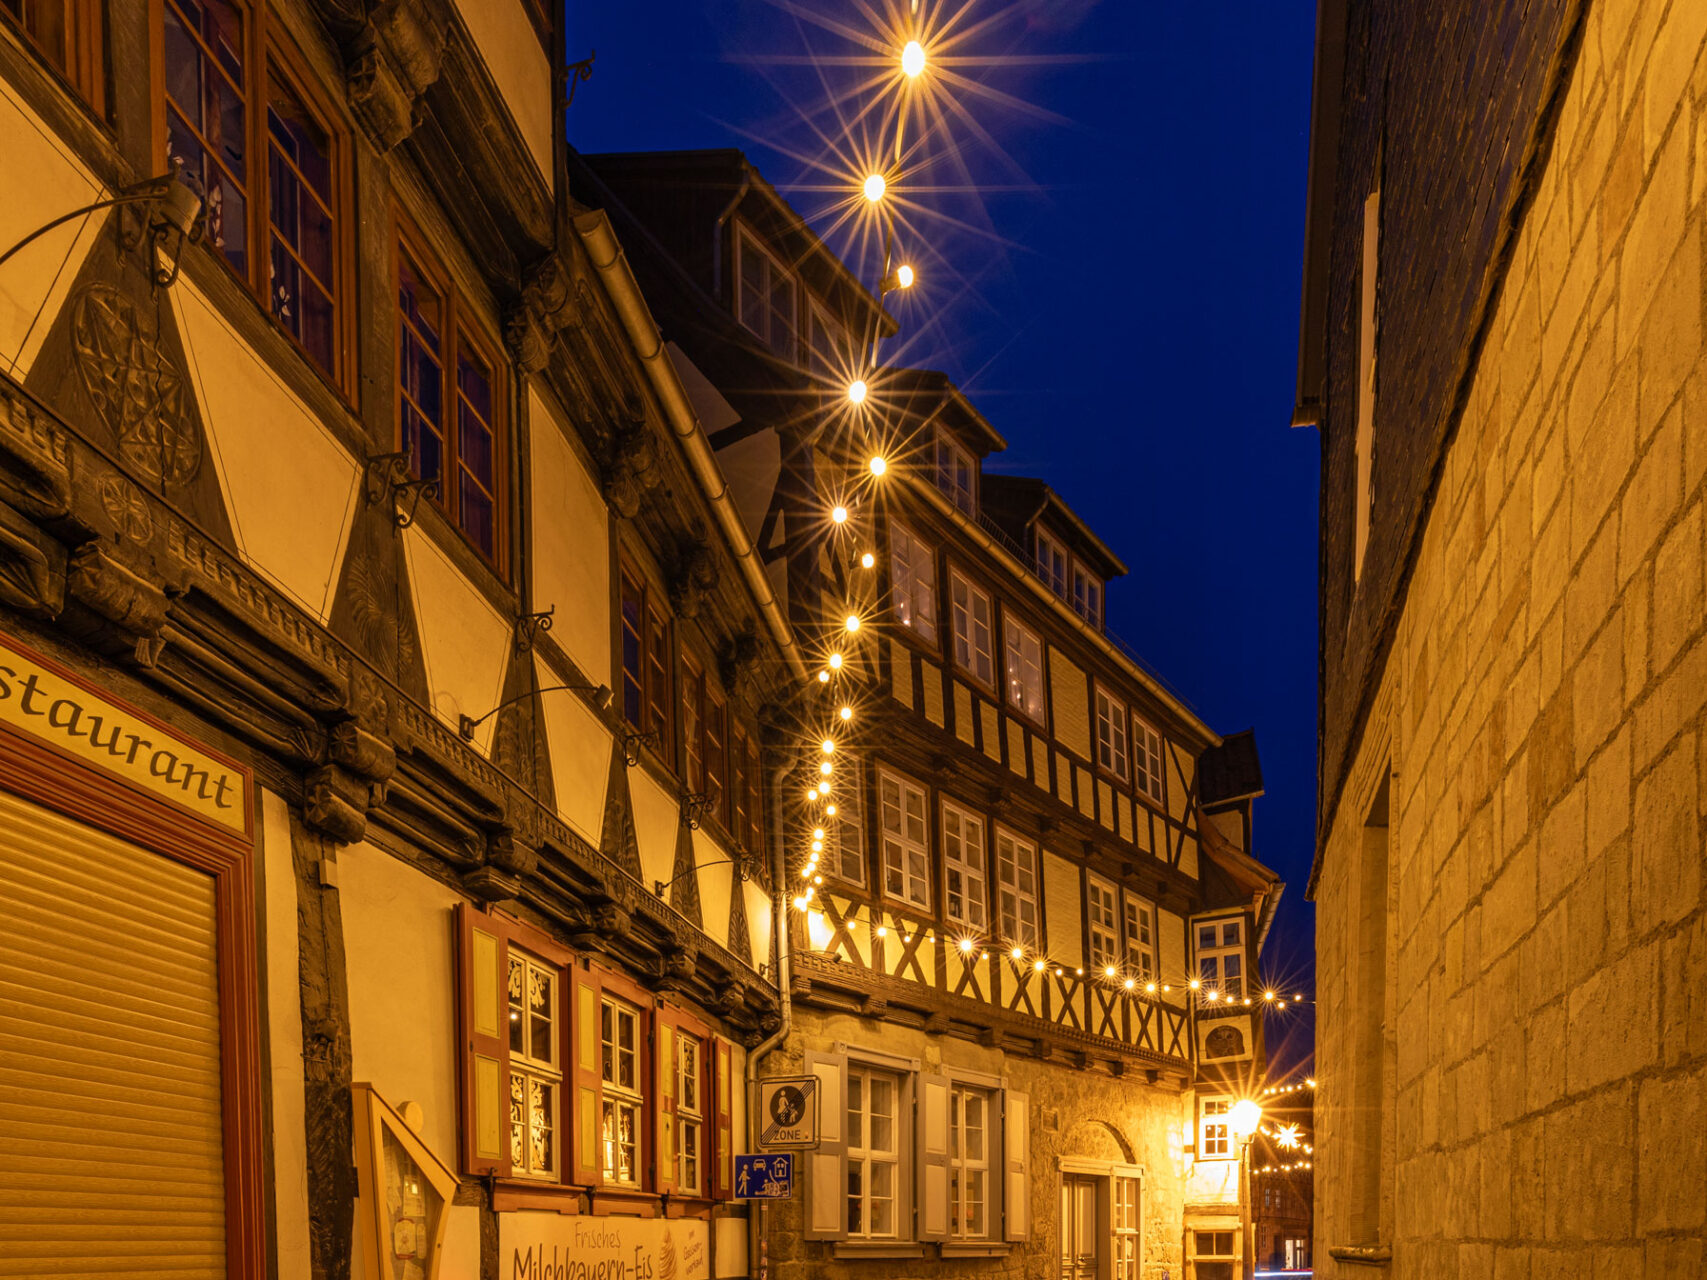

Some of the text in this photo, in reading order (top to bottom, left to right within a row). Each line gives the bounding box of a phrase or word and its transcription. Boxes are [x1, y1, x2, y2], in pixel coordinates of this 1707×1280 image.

[0, 665, 233, 809] staurant
[774, 1129, 801, 1141] ZONE
[574, 1221, 621, 1255] Frisches
